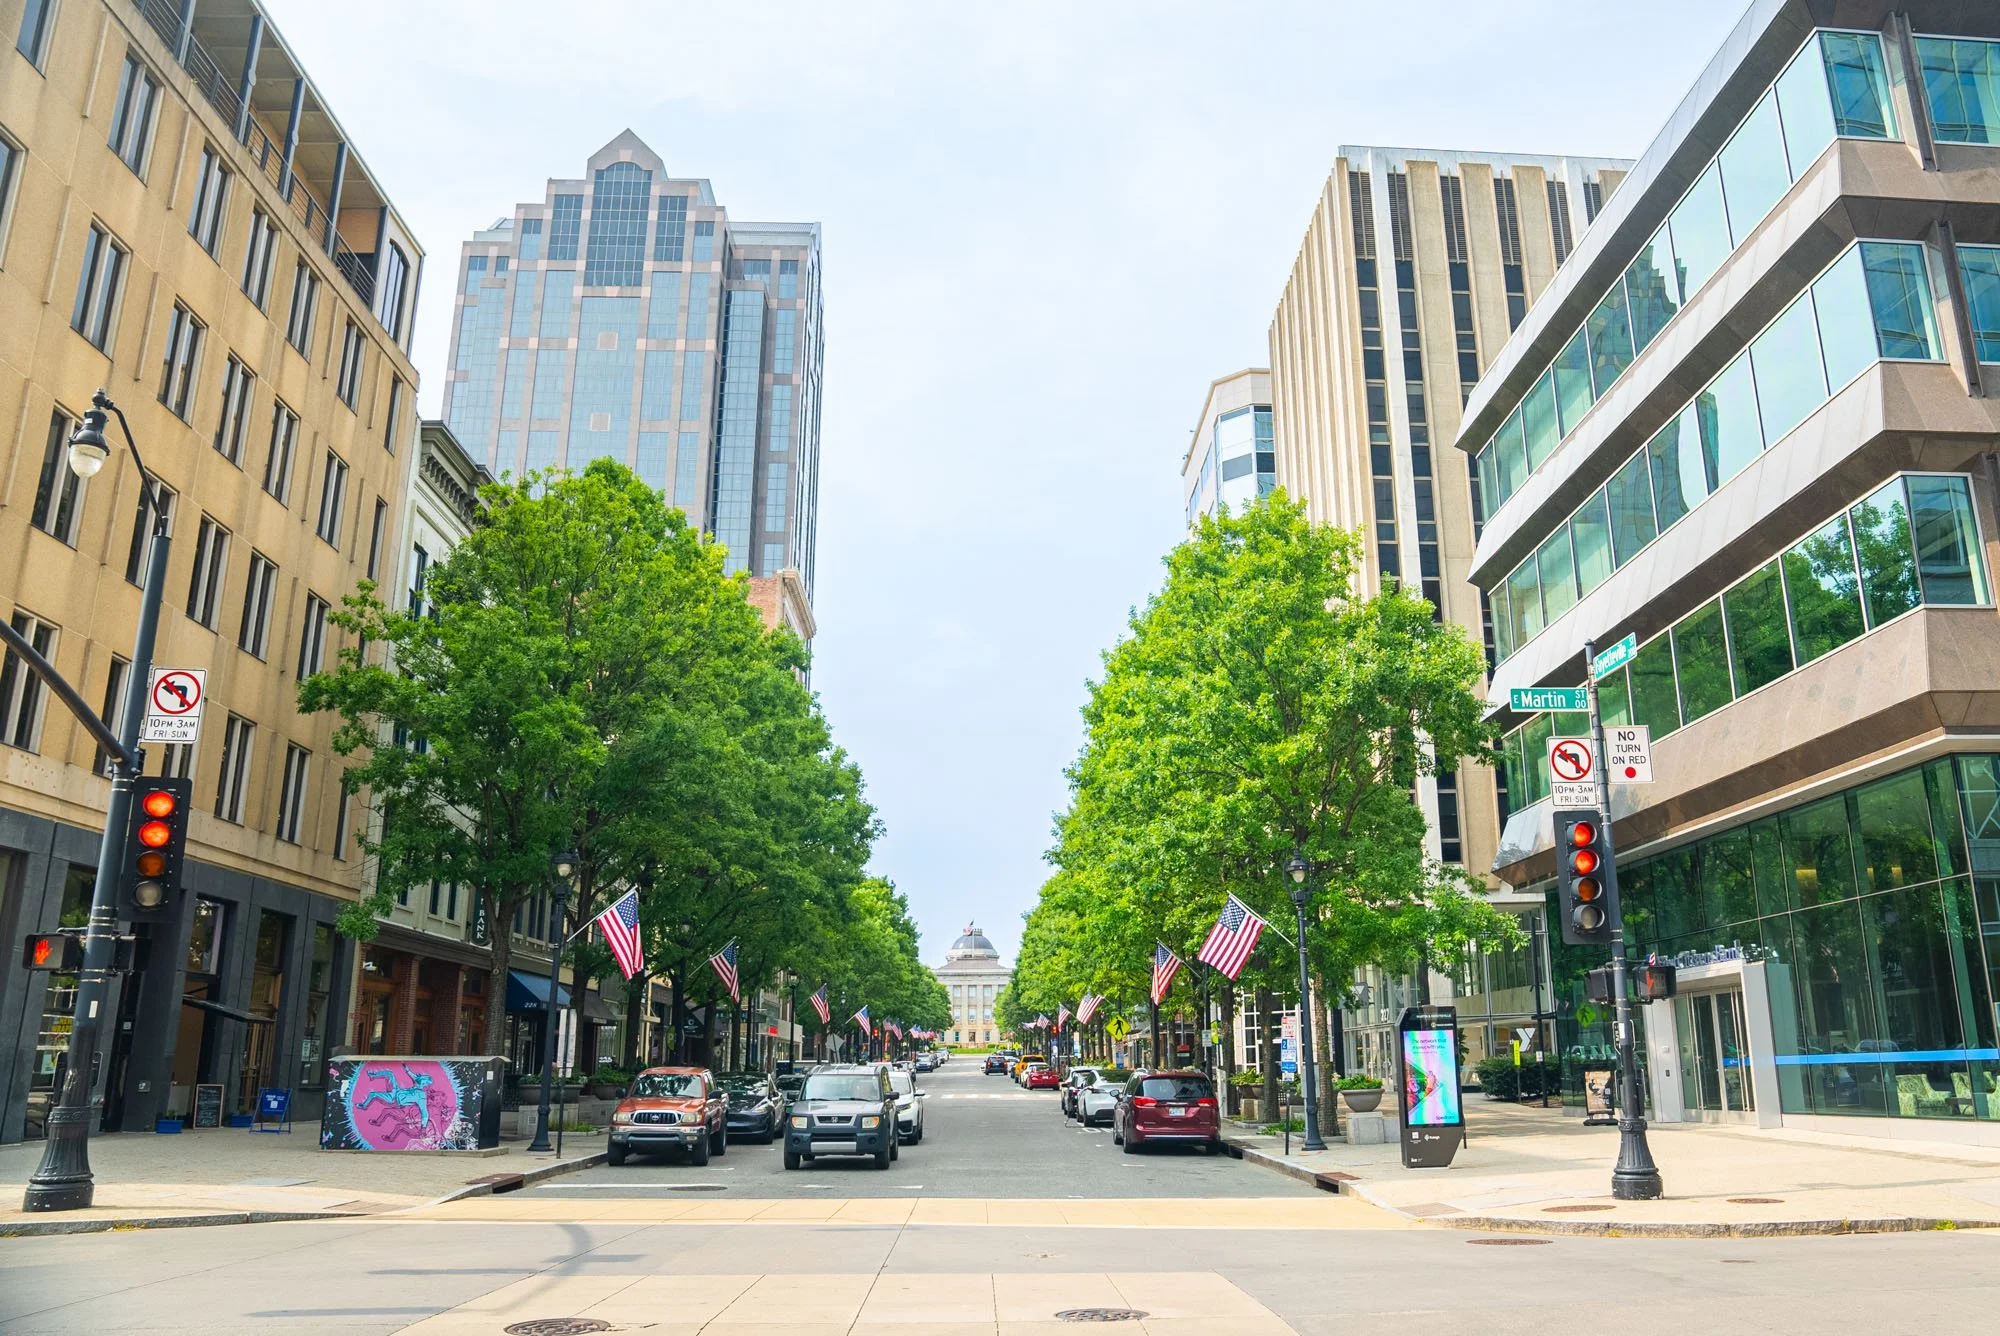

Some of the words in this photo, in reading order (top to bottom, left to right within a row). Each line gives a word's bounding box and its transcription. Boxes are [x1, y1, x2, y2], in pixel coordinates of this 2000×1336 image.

[1513, 694, 1519, 704] E
[1521, 690, 1566, 708] Martin
[1575, 690, 1585, 699] ST
[1575, 700, 1587, 708] 00
[1618, 731, 1635, 741] NO
[1616, 744, 1641, 753] TURN
[1612, 756, 1625, 765] ON
[1628, 755, 1646, 764] RED
[476, 909, 485, 939] BANK
[1282, 1040, 1287, 1049] 2
